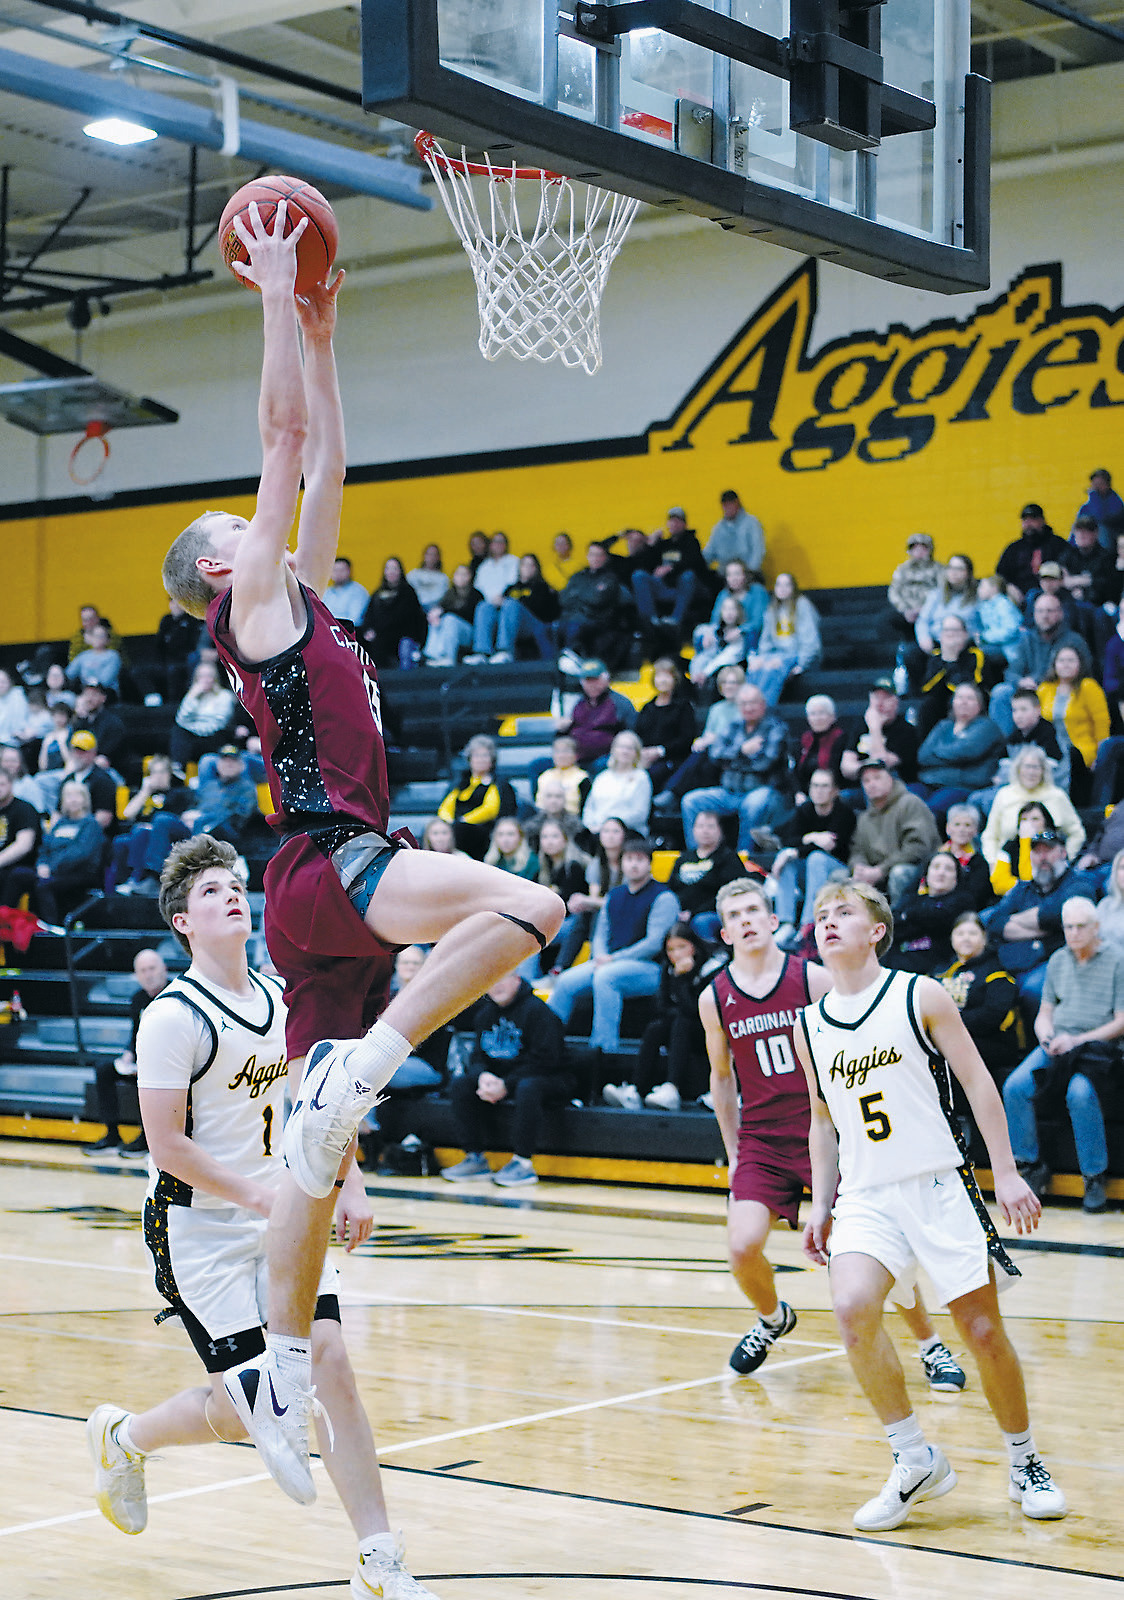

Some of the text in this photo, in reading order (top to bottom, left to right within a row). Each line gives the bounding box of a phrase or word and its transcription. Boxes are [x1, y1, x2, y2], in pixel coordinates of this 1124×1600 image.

[228, 1054, 288, 1099] Aggie
[755, 1033, 796, 1078] 10
[829, 1045, 902, 1089] Aggies
[262, 1104, 273, 1156] 1
[859, 1091, 892, 1142] 5
